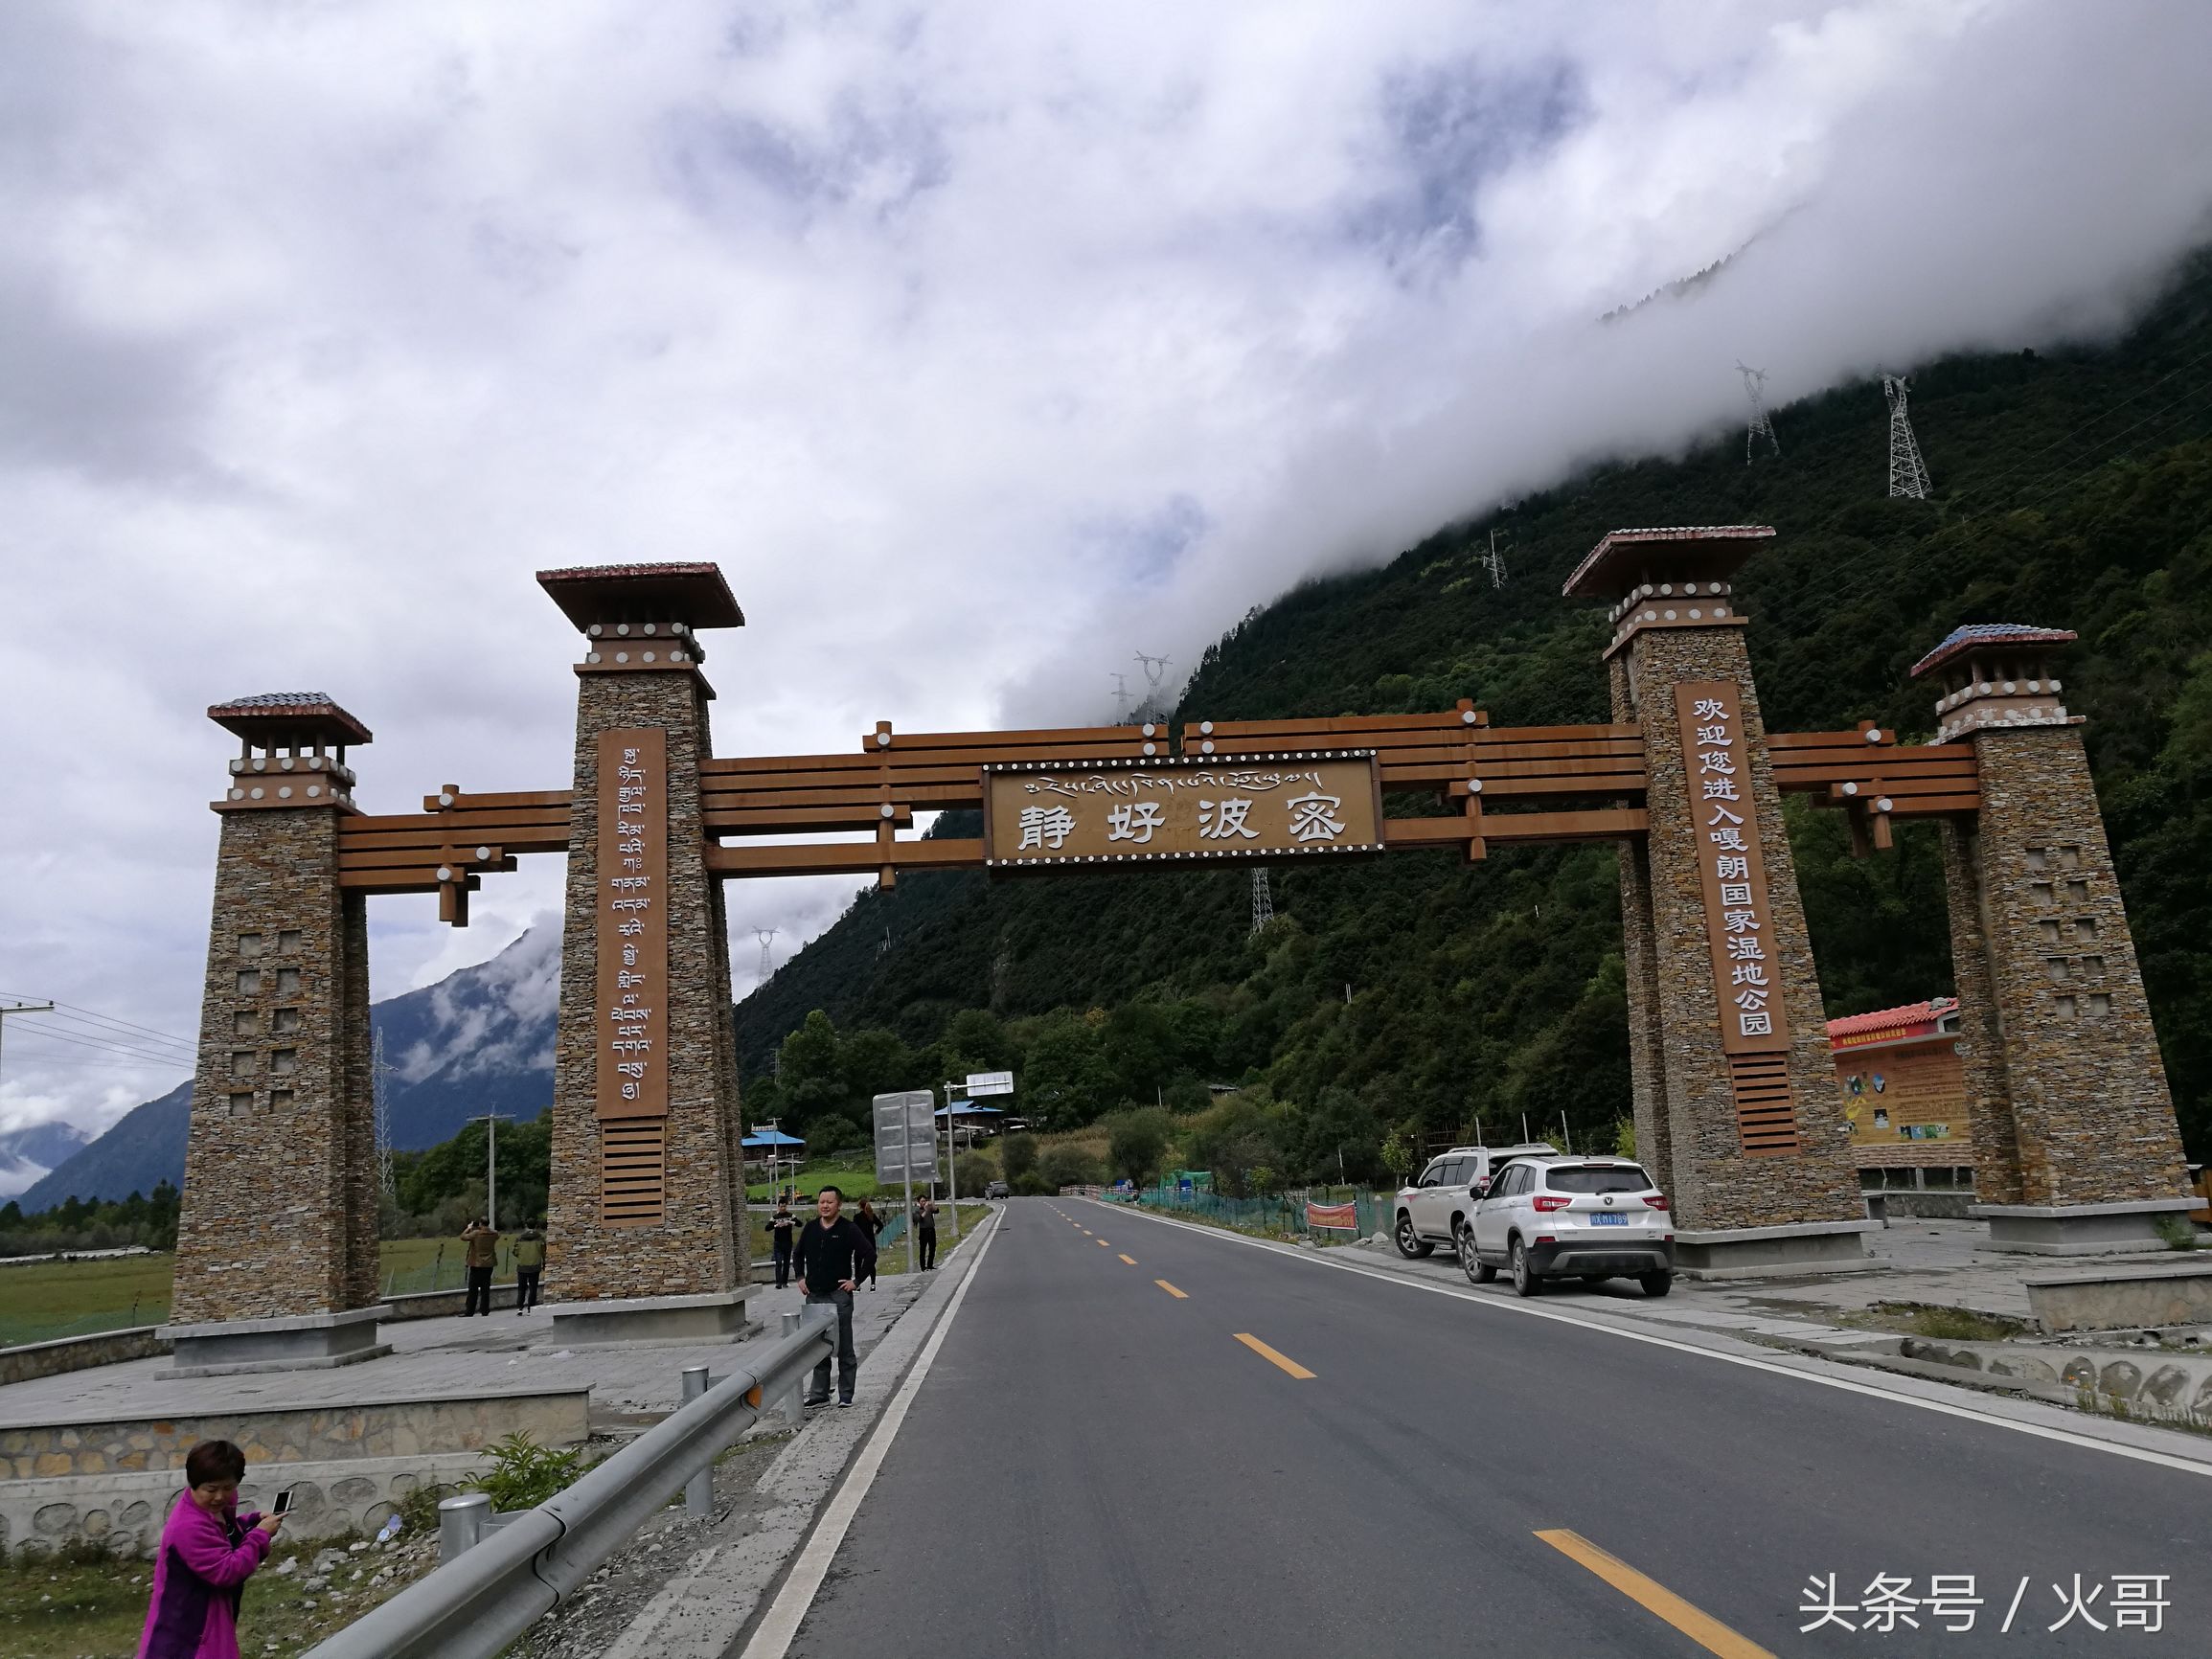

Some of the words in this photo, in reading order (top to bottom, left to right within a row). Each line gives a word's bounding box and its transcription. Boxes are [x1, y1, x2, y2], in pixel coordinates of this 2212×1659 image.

[1017, 791, 1346, 852] 静好波密
[1693, 698, 1772, 1036] 欢迎您进入嘎朗国家湿地公园
